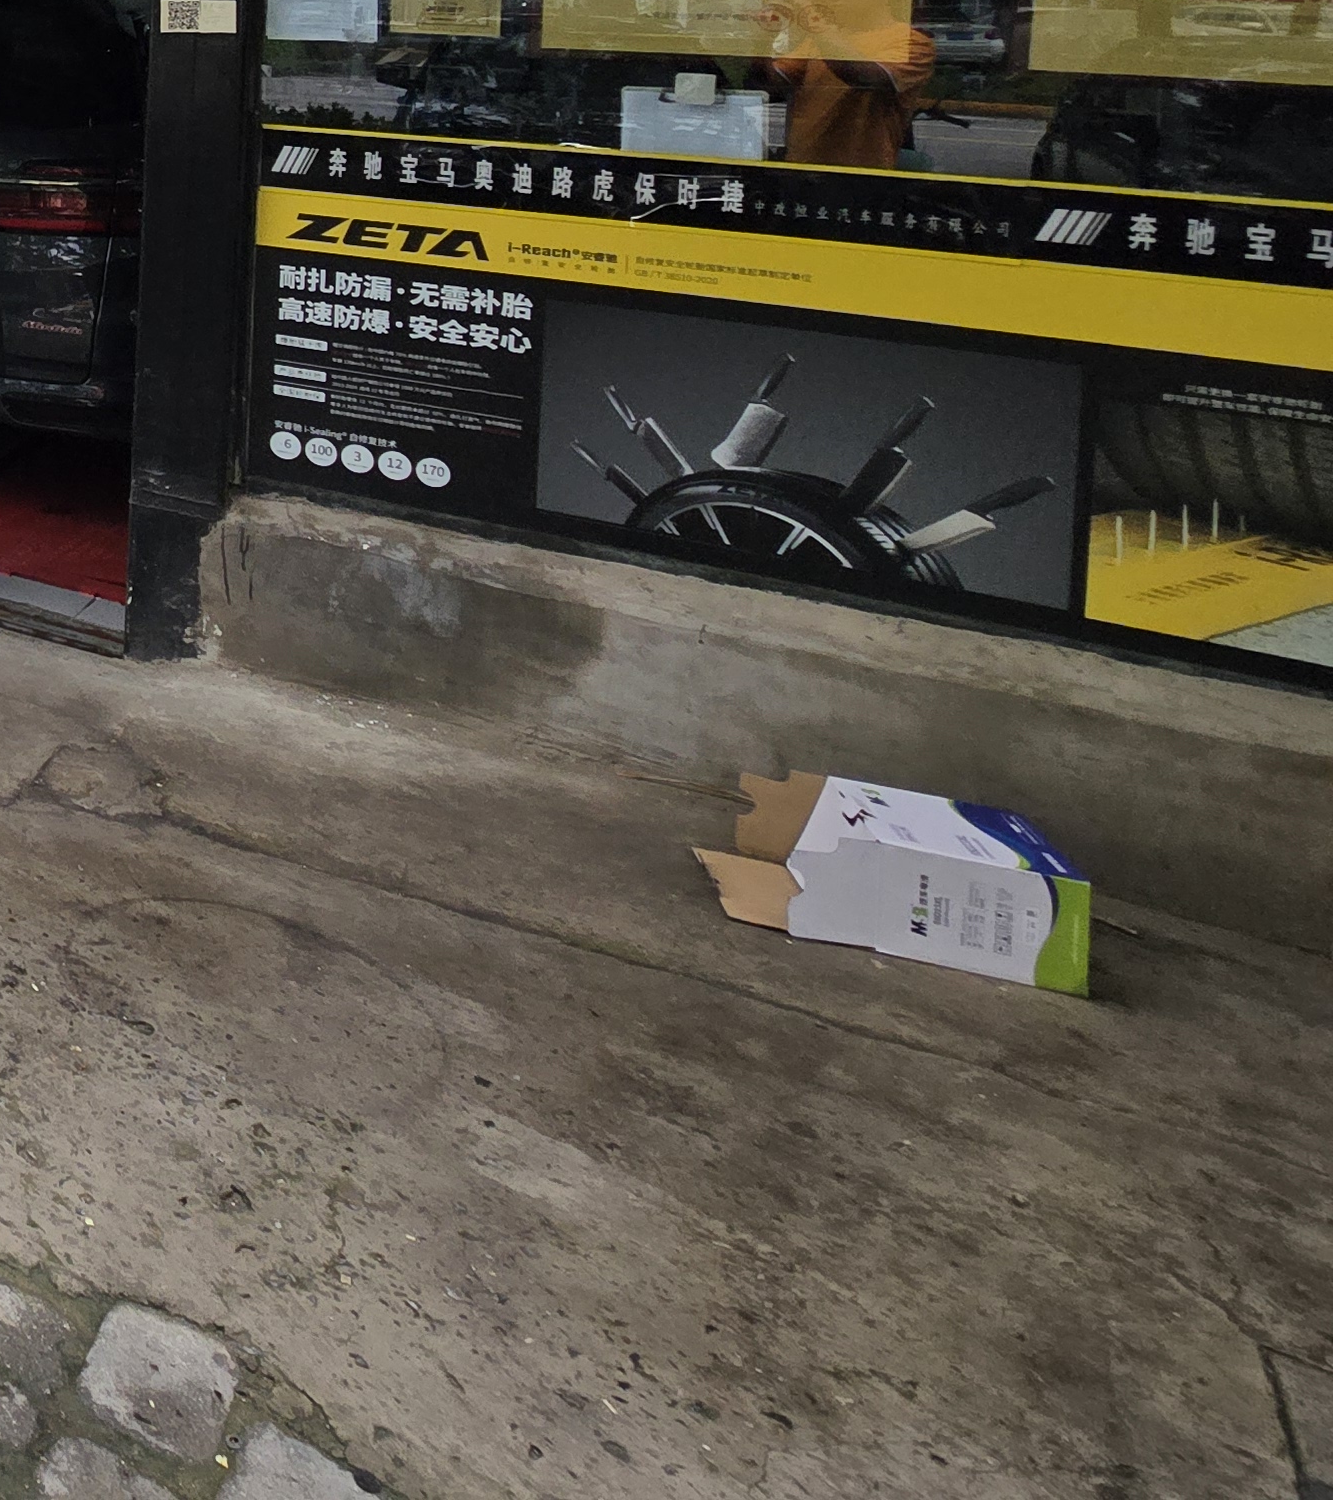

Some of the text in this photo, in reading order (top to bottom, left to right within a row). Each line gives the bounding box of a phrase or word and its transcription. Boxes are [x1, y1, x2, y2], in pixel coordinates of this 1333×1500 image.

[328, 146, 745, 214] 奔驰宝马奥迪路虎保时捷
[286, 213, 490, 263] ZETA
[310, 443, 333, 457] 100
[353, 451, 362, 463] 3
[386, 457, 403, 471] 12
[422, 464, 445, 479] 170
